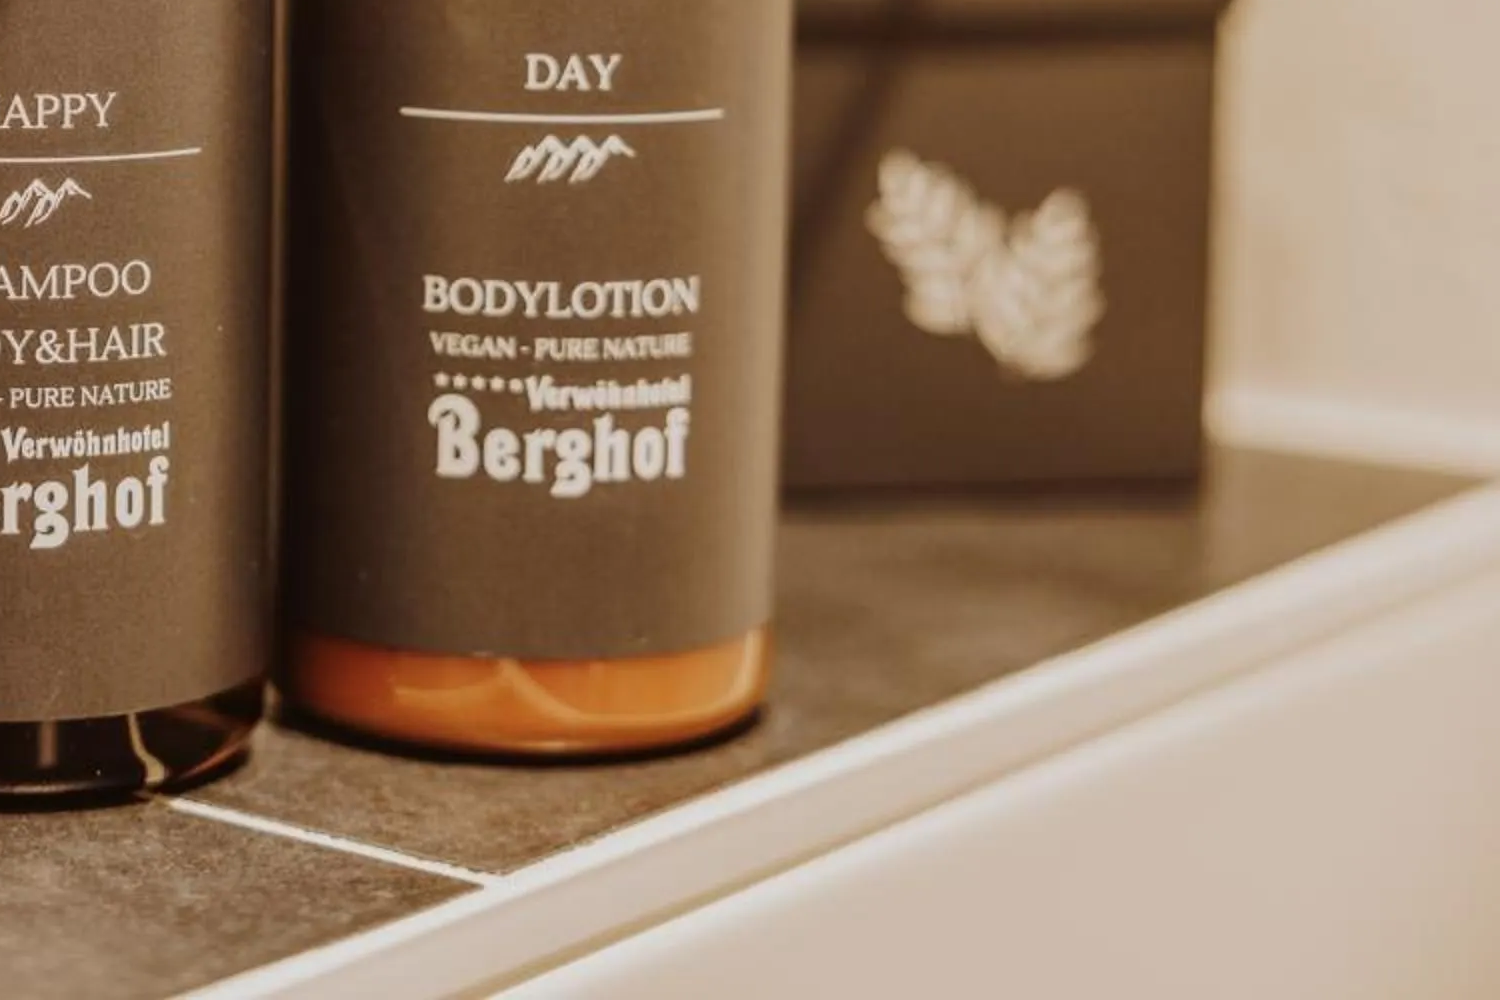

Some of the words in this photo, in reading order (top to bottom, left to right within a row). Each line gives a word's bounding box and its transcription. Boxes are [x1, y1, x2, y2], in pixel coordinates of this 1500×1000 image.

[524, 53, 622, 91] DAY
[422, 274, 700, 319] BODYLOTION
[429, 331, 517, 359] VEGAN
[534, 337, 600, 361] PURE
[602, 331, 692, 360] NATURE
[9, 386, 75, 409] PURE
[80, 377, 173, 407] NATURE
[0, 420, 170, 462] Verwöhnhotel
[427, 393, 691, 498] Berghof
